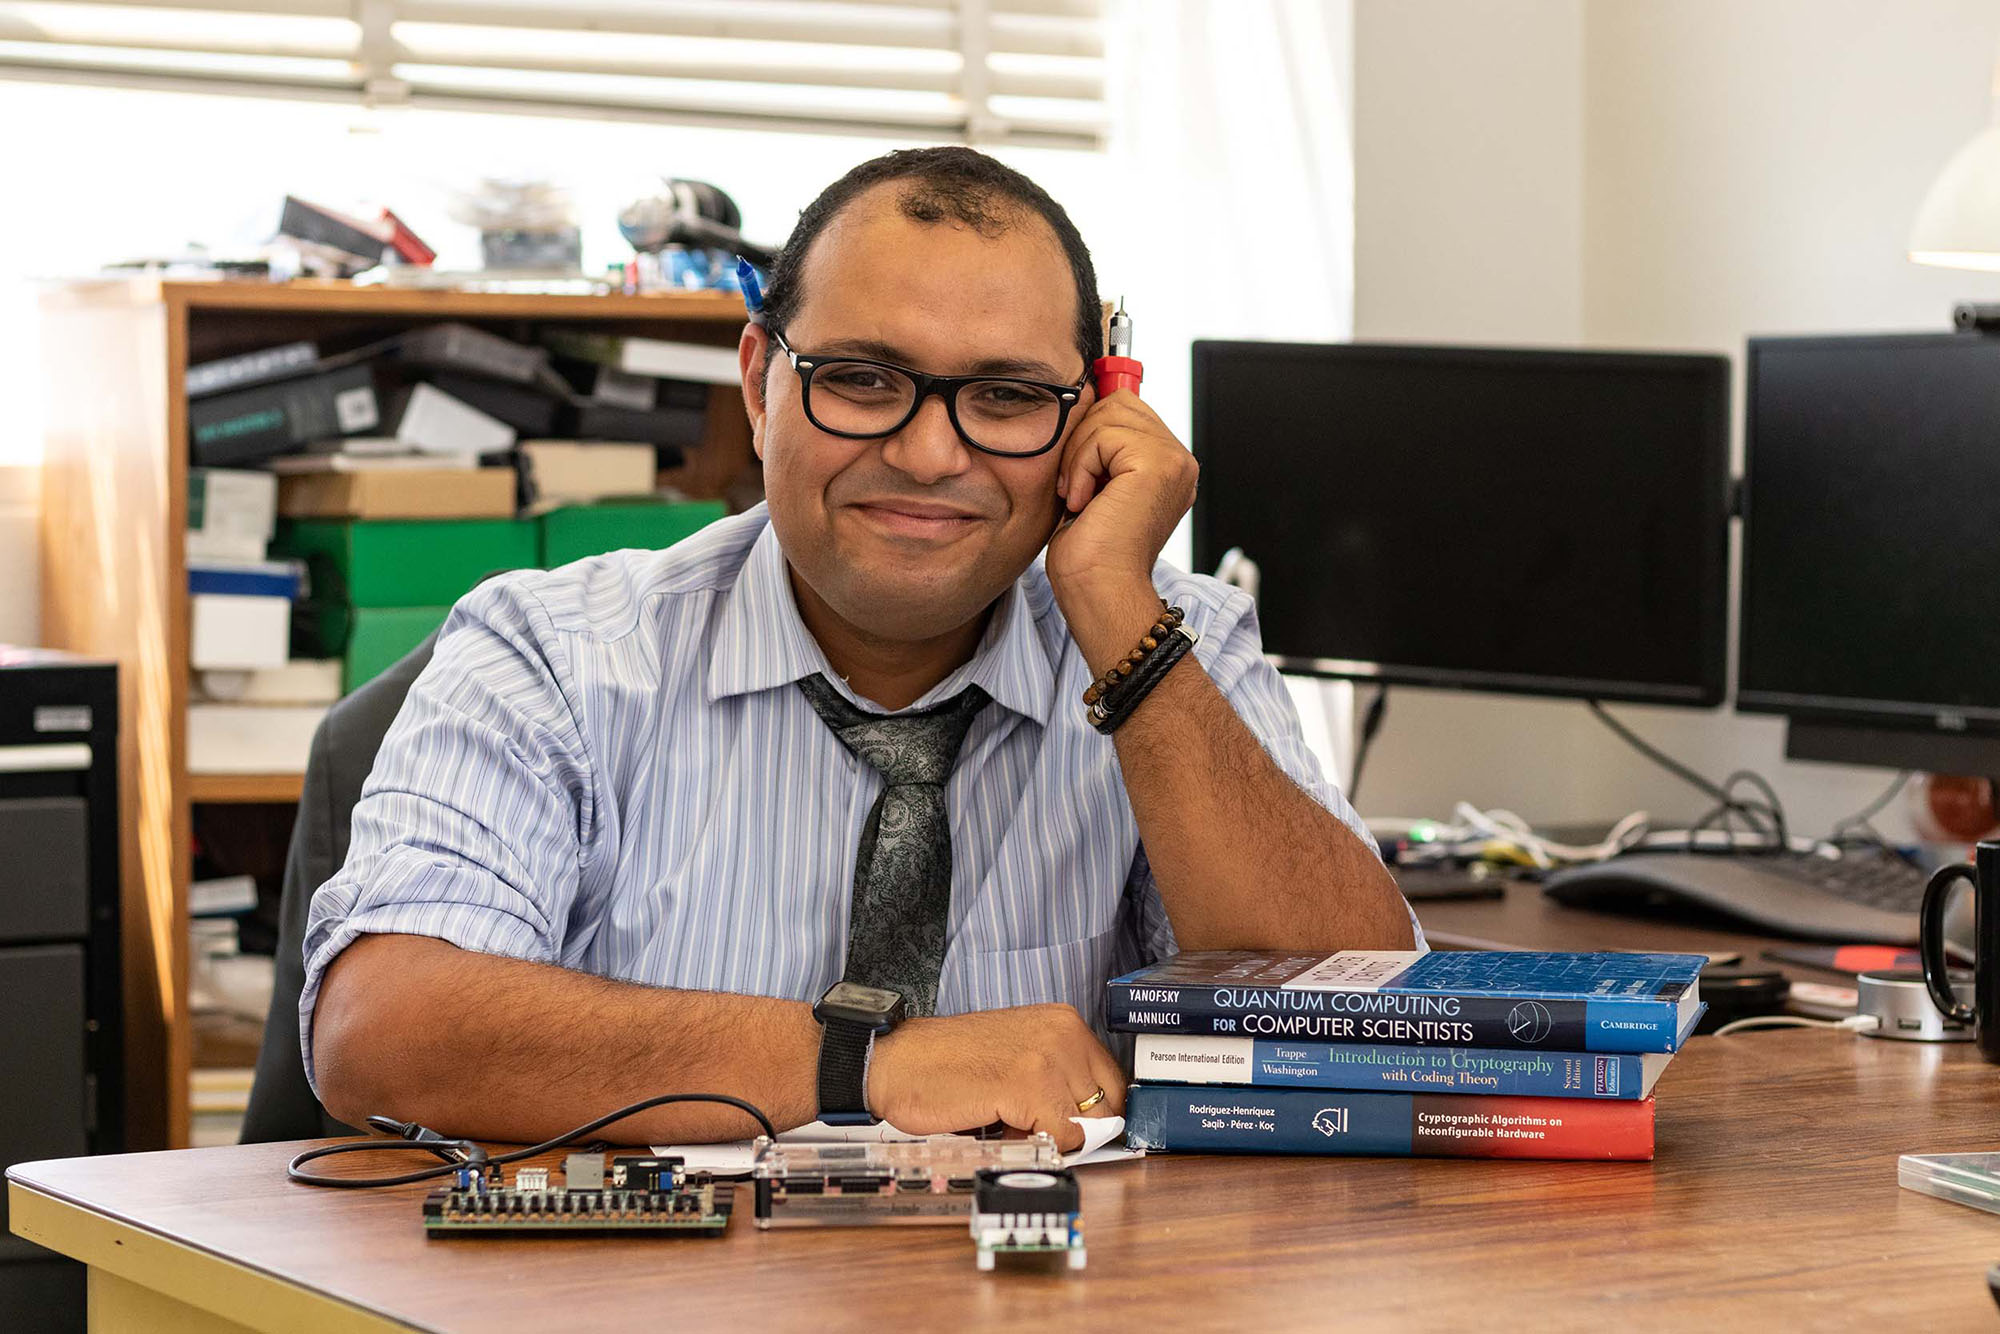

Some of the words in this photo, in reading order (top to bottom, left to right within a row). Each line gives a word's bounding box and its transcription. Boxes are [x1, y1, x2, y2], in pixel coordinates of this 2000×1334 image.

[1129, 989, 1180, 1003] YANOFSKY
[1213, 988, 1324, 1011] QUANTUM
[1331, 993, 1461, 1017] COMPUTING
[1128, 1011, 1180, 1025] MANNUCCI
[1213, 1018, 1236, 1032] FOR
[1242, 1014, 1355, 1037] COMPUTER
[1362, 1018, 1474, 1042] SCIENTISTS
[1601, 1020, 1659, 1031] CAMBRIDGE
[1150, 1051, 1177, 1062] Pearson
[1178, 1052, 1220, 1064] International
[1222, 1054, 1245, 1065] Edition
[1275, 1047, 1307, 1060] Trappe
[1328, 1047, 1426, 1067] Introduction
[1431, 1053, 1447, 1068] to
[1451, 1053, 1554, 1077] Cryptography
[1262, 1063, 1318, 1077] Washington
[1563, 1058, 1572, 1089] Second
[1572, 1059, 1581, 1089] Edition
[1596, 1060, 1604, 1092] PEARSON
[1382, 1069, 1407, 1081] with
[1411, 1070, 1455, 1086] Coding
[1457, 1071, 1500, 1088] Theory
[1201, 1119, 1225, 1130] Saqib
[1230, 1119, 1254, 1130] Pérez
[1259, 1121, 1275, 1132] Koç
[1418, 1112, 1489, 1125] Cryptographic
[1491, 1114, 1547, 1127] Algorithms
[1549, 1118, 1562, 1126] on
[1418, 1126, 1494, 1139] Reconfigurable
[1496, 1128, 1545, 1140] Hardware
